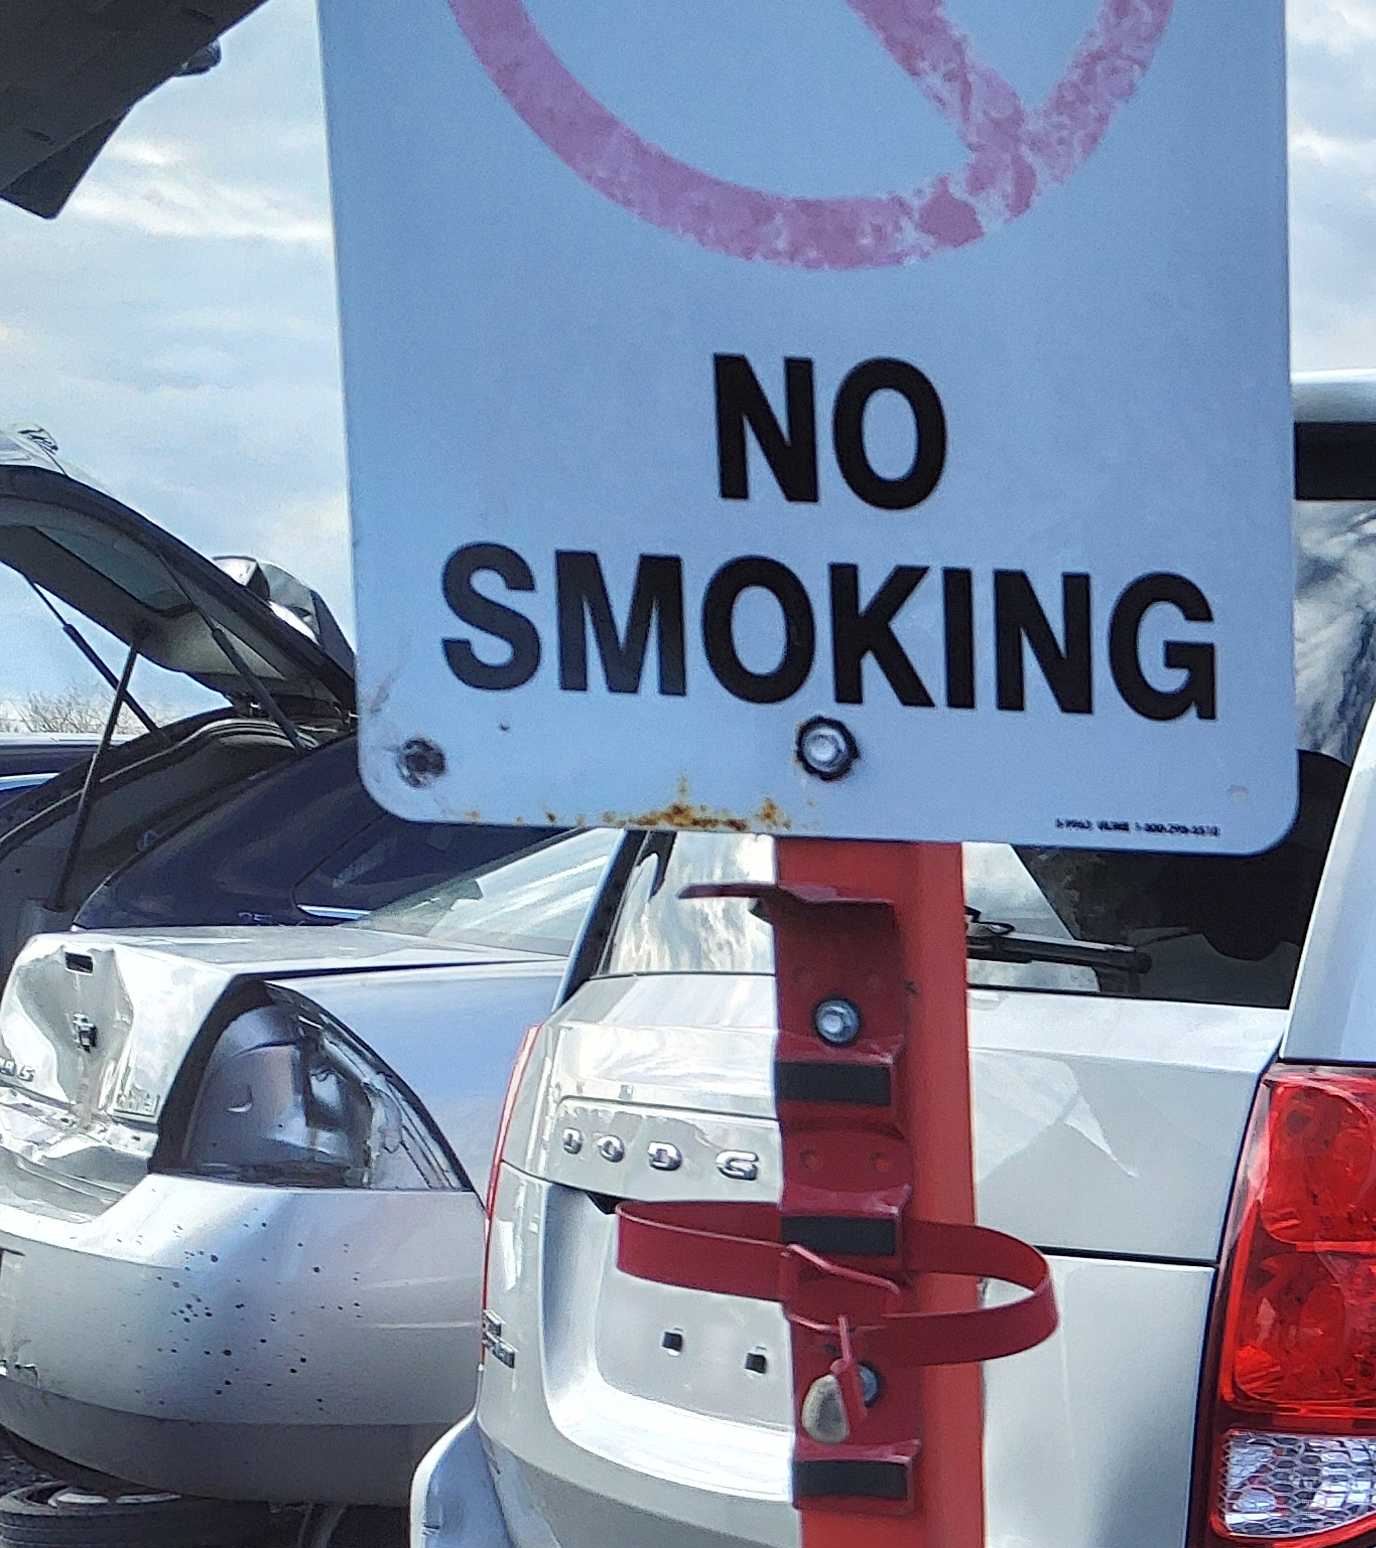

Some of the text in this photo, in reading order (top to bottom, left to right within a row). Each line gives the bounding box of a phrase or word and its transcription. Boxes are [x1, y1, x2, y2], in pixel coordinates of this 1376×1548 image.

[712, 352, 949, 511] NO
[439, 541, 1219, 721] SMOKING
[562, 1127, 760, 1182] DODG
